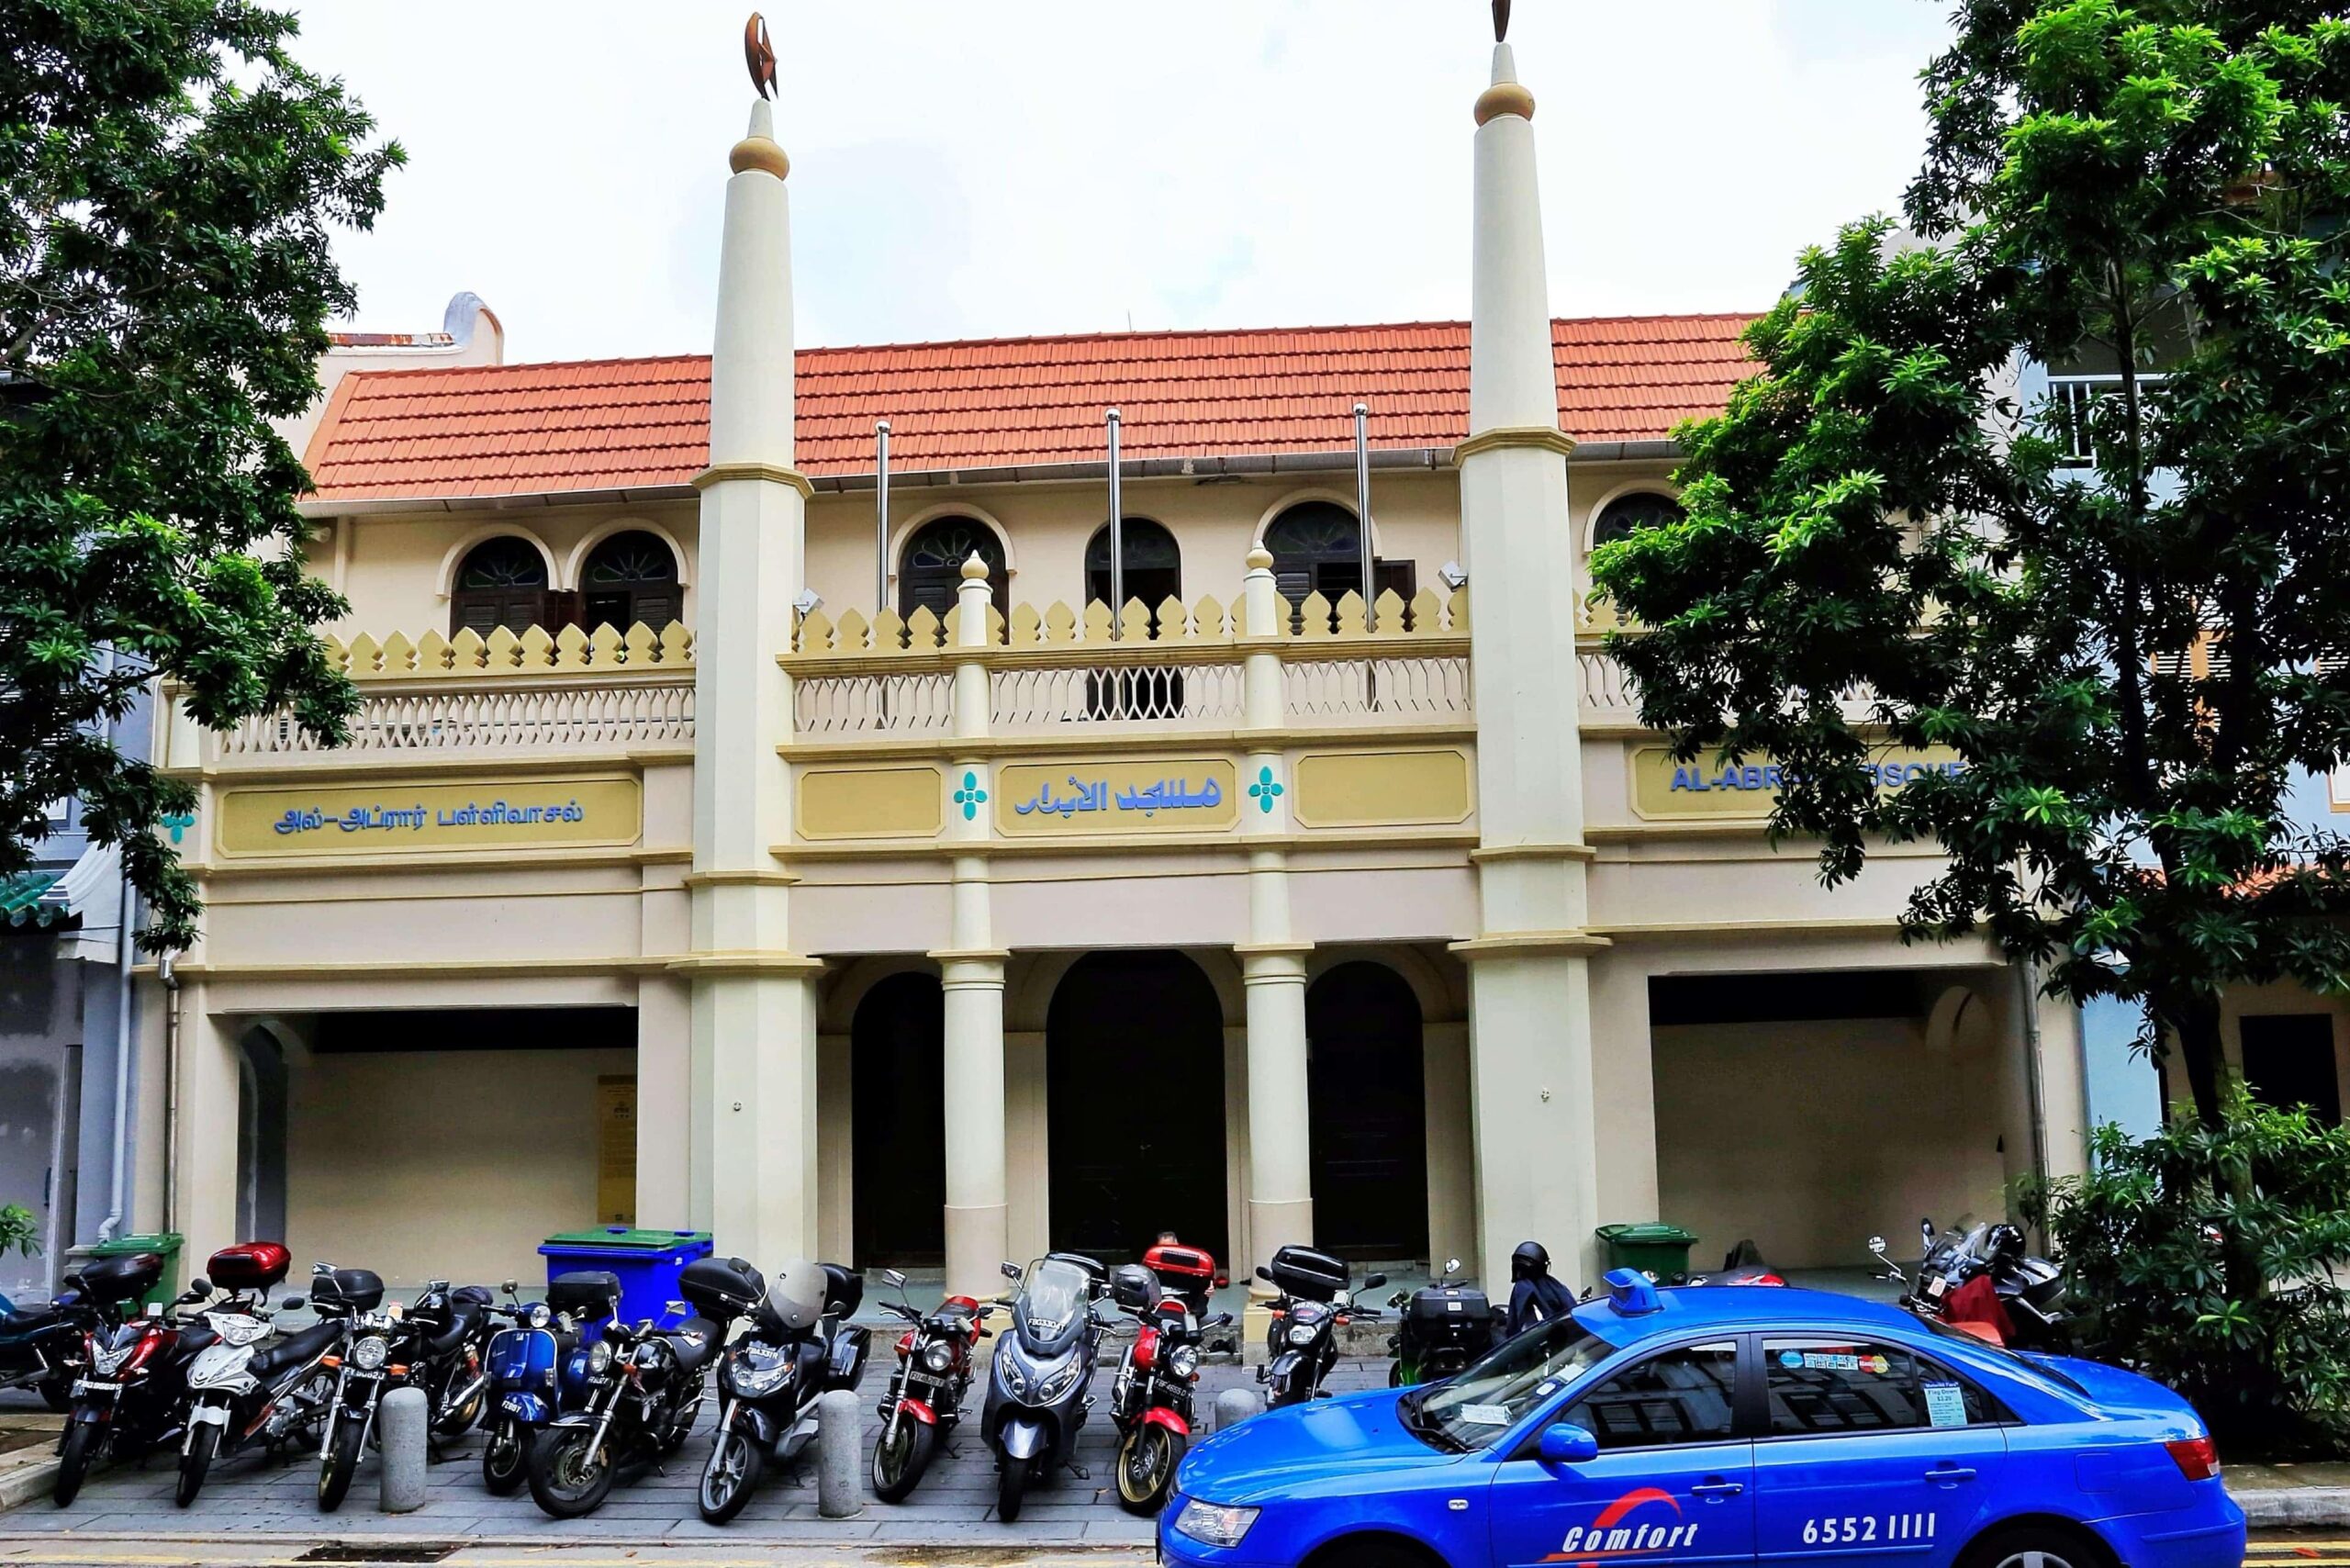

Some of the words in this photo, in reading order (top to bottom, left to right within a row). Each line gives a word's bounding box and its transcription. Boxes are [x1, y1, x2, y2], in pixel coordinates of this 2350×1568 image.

[1672, 766, 1814, 790] AL-ABR
[1114, 778, 1222, 817] مسجد
[437, 800, 584, 826] பள்ளிவாசல்
[1561, 1523, 1698, 1552] Comfort
[1803, 1516, 1876, 1544] 6552
[1888, 1512, 1935, 1540] 1111
